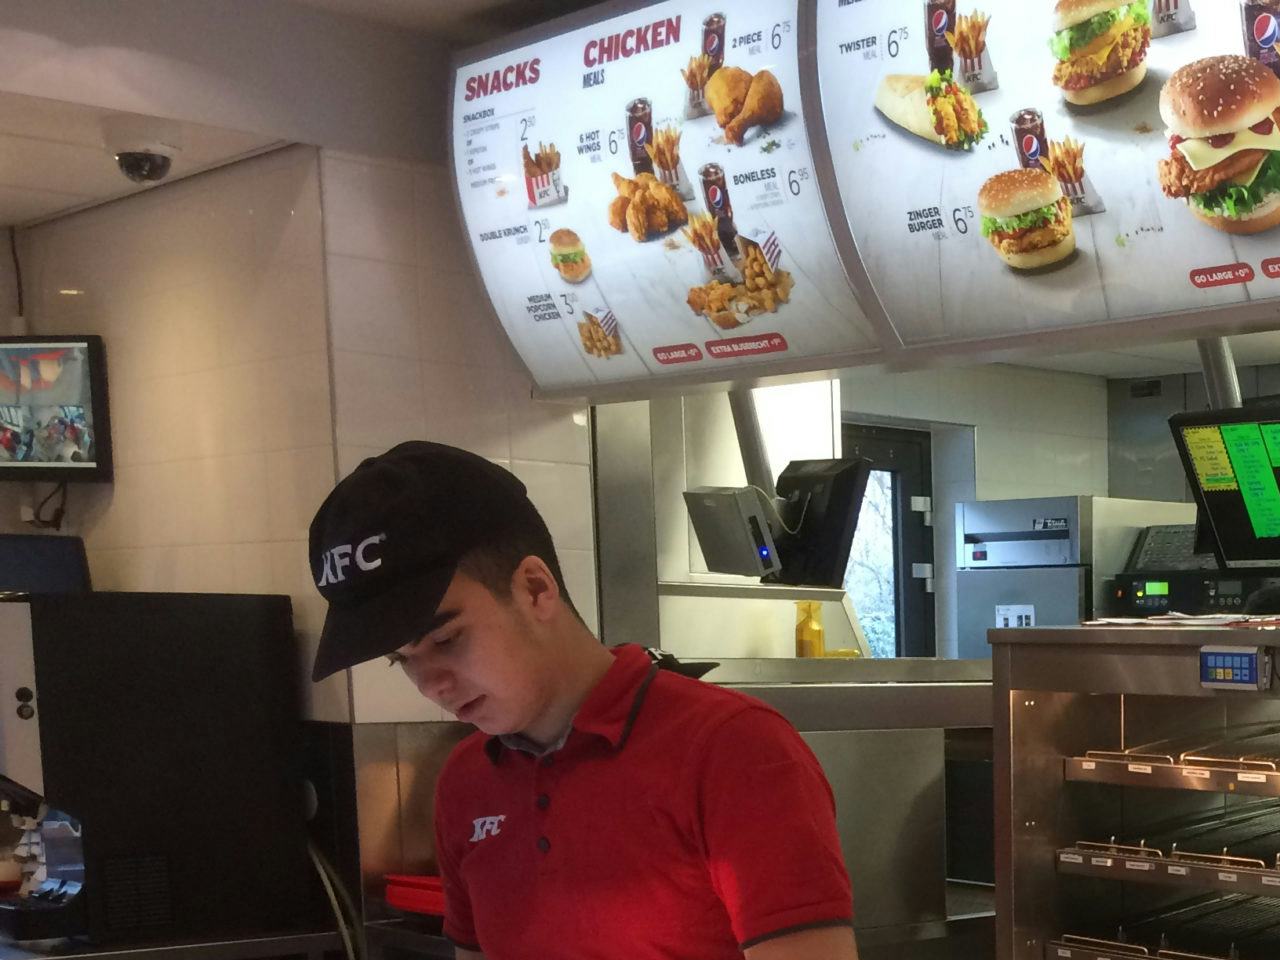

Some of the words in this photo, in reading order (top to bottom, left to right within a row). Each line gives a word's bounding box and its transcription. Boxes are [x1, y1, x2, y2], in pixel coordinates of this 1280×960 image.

[583, 15, 682, 68] CHICKEN
[732, 38, 737, 48] 2
[739, 31, 762, 45] PIECE
[838, 36, 877, 54] TWISTER
[464, 58, 541, 101] SNACKS
[463, 108, 495, 123] SNACKBOX
[579, 135, 584, 144] 6
[585, 130, 599, 142] HOT
[577, 142, 601, 155] WINGS
[733, 168, 776, 186] BONELESS
[907, 206, 941, 222] ZINGER
[908, 218, 944, 233] BURGER
[1194, 275, 1207, 284] GO
[1207, 271, 1233, 282] LARGE
[318, 532, 387, 588] KFC
